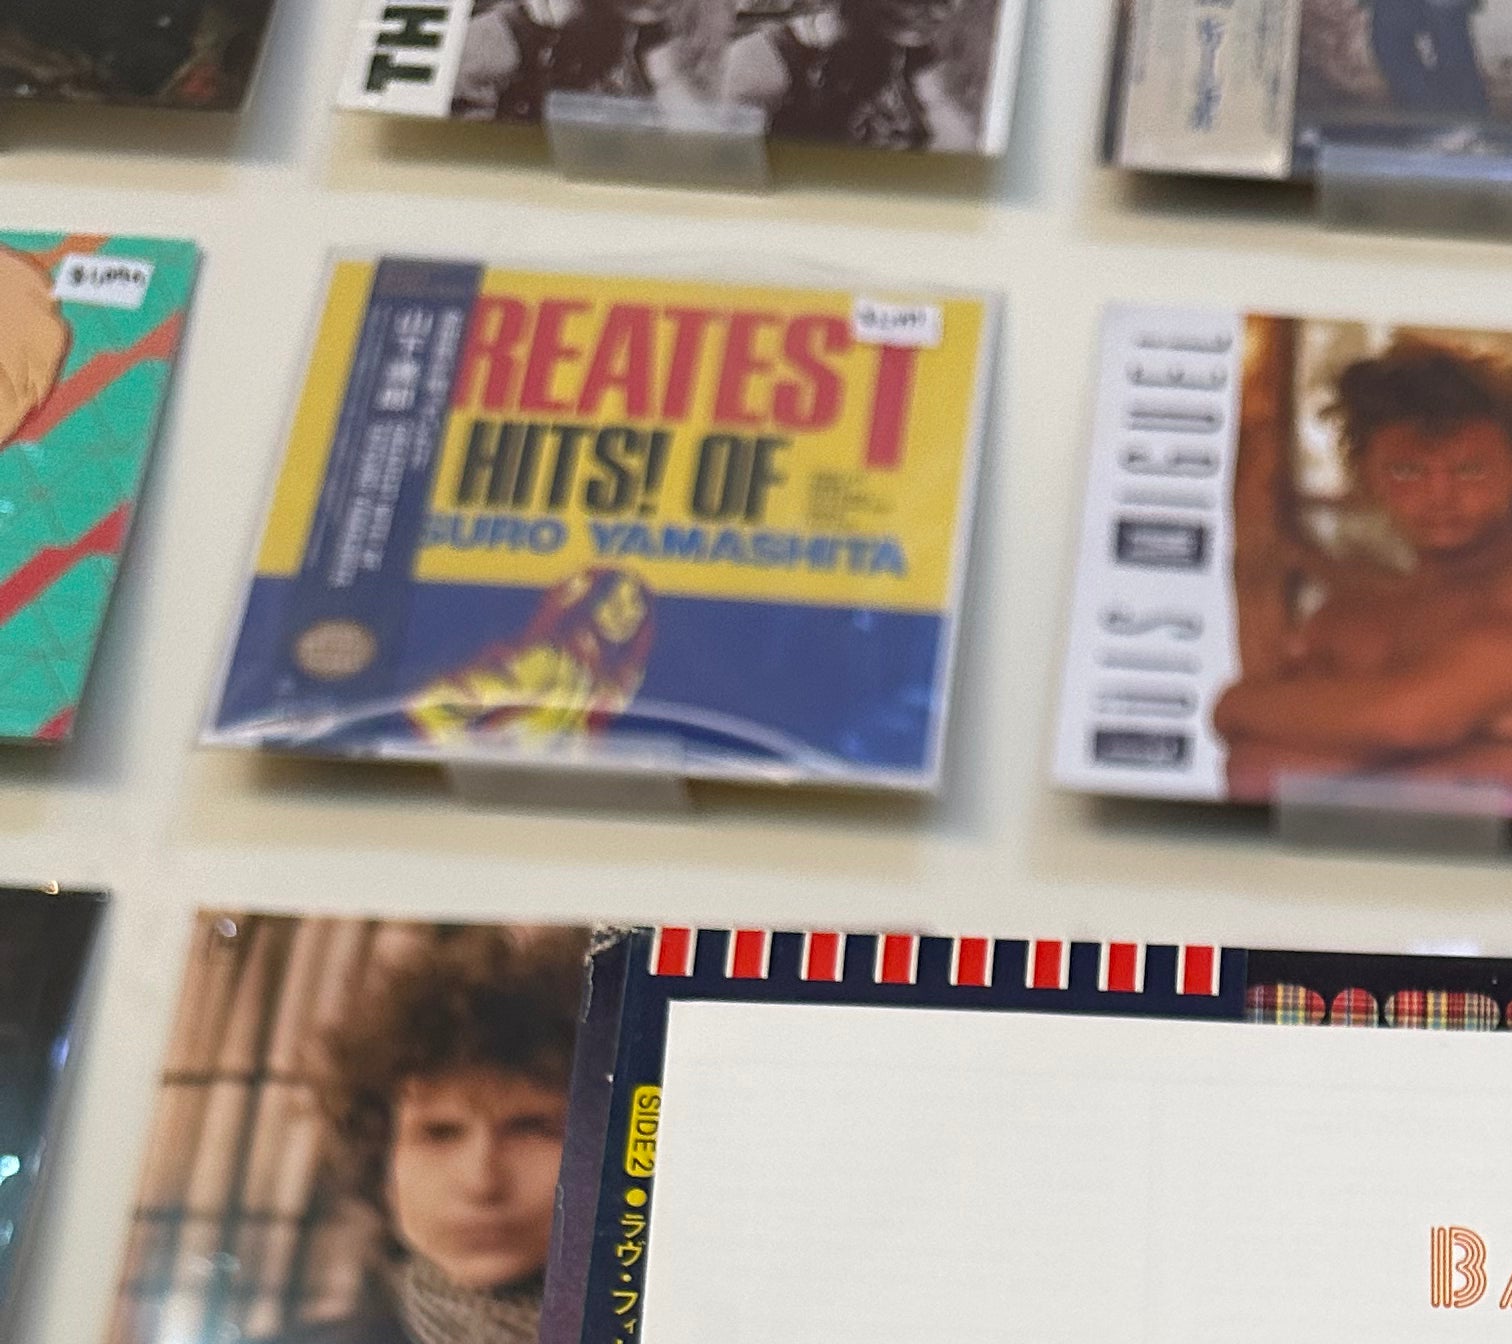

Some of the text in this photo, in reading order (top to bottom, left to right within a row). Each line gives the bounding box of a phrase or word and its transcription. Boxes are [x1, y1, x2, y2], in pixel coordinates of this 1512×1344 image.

[456, 418, 672, 516] HITS!
[690, 434, 794, 524] OF
[633, 1094, 661, 1153] SIDE
